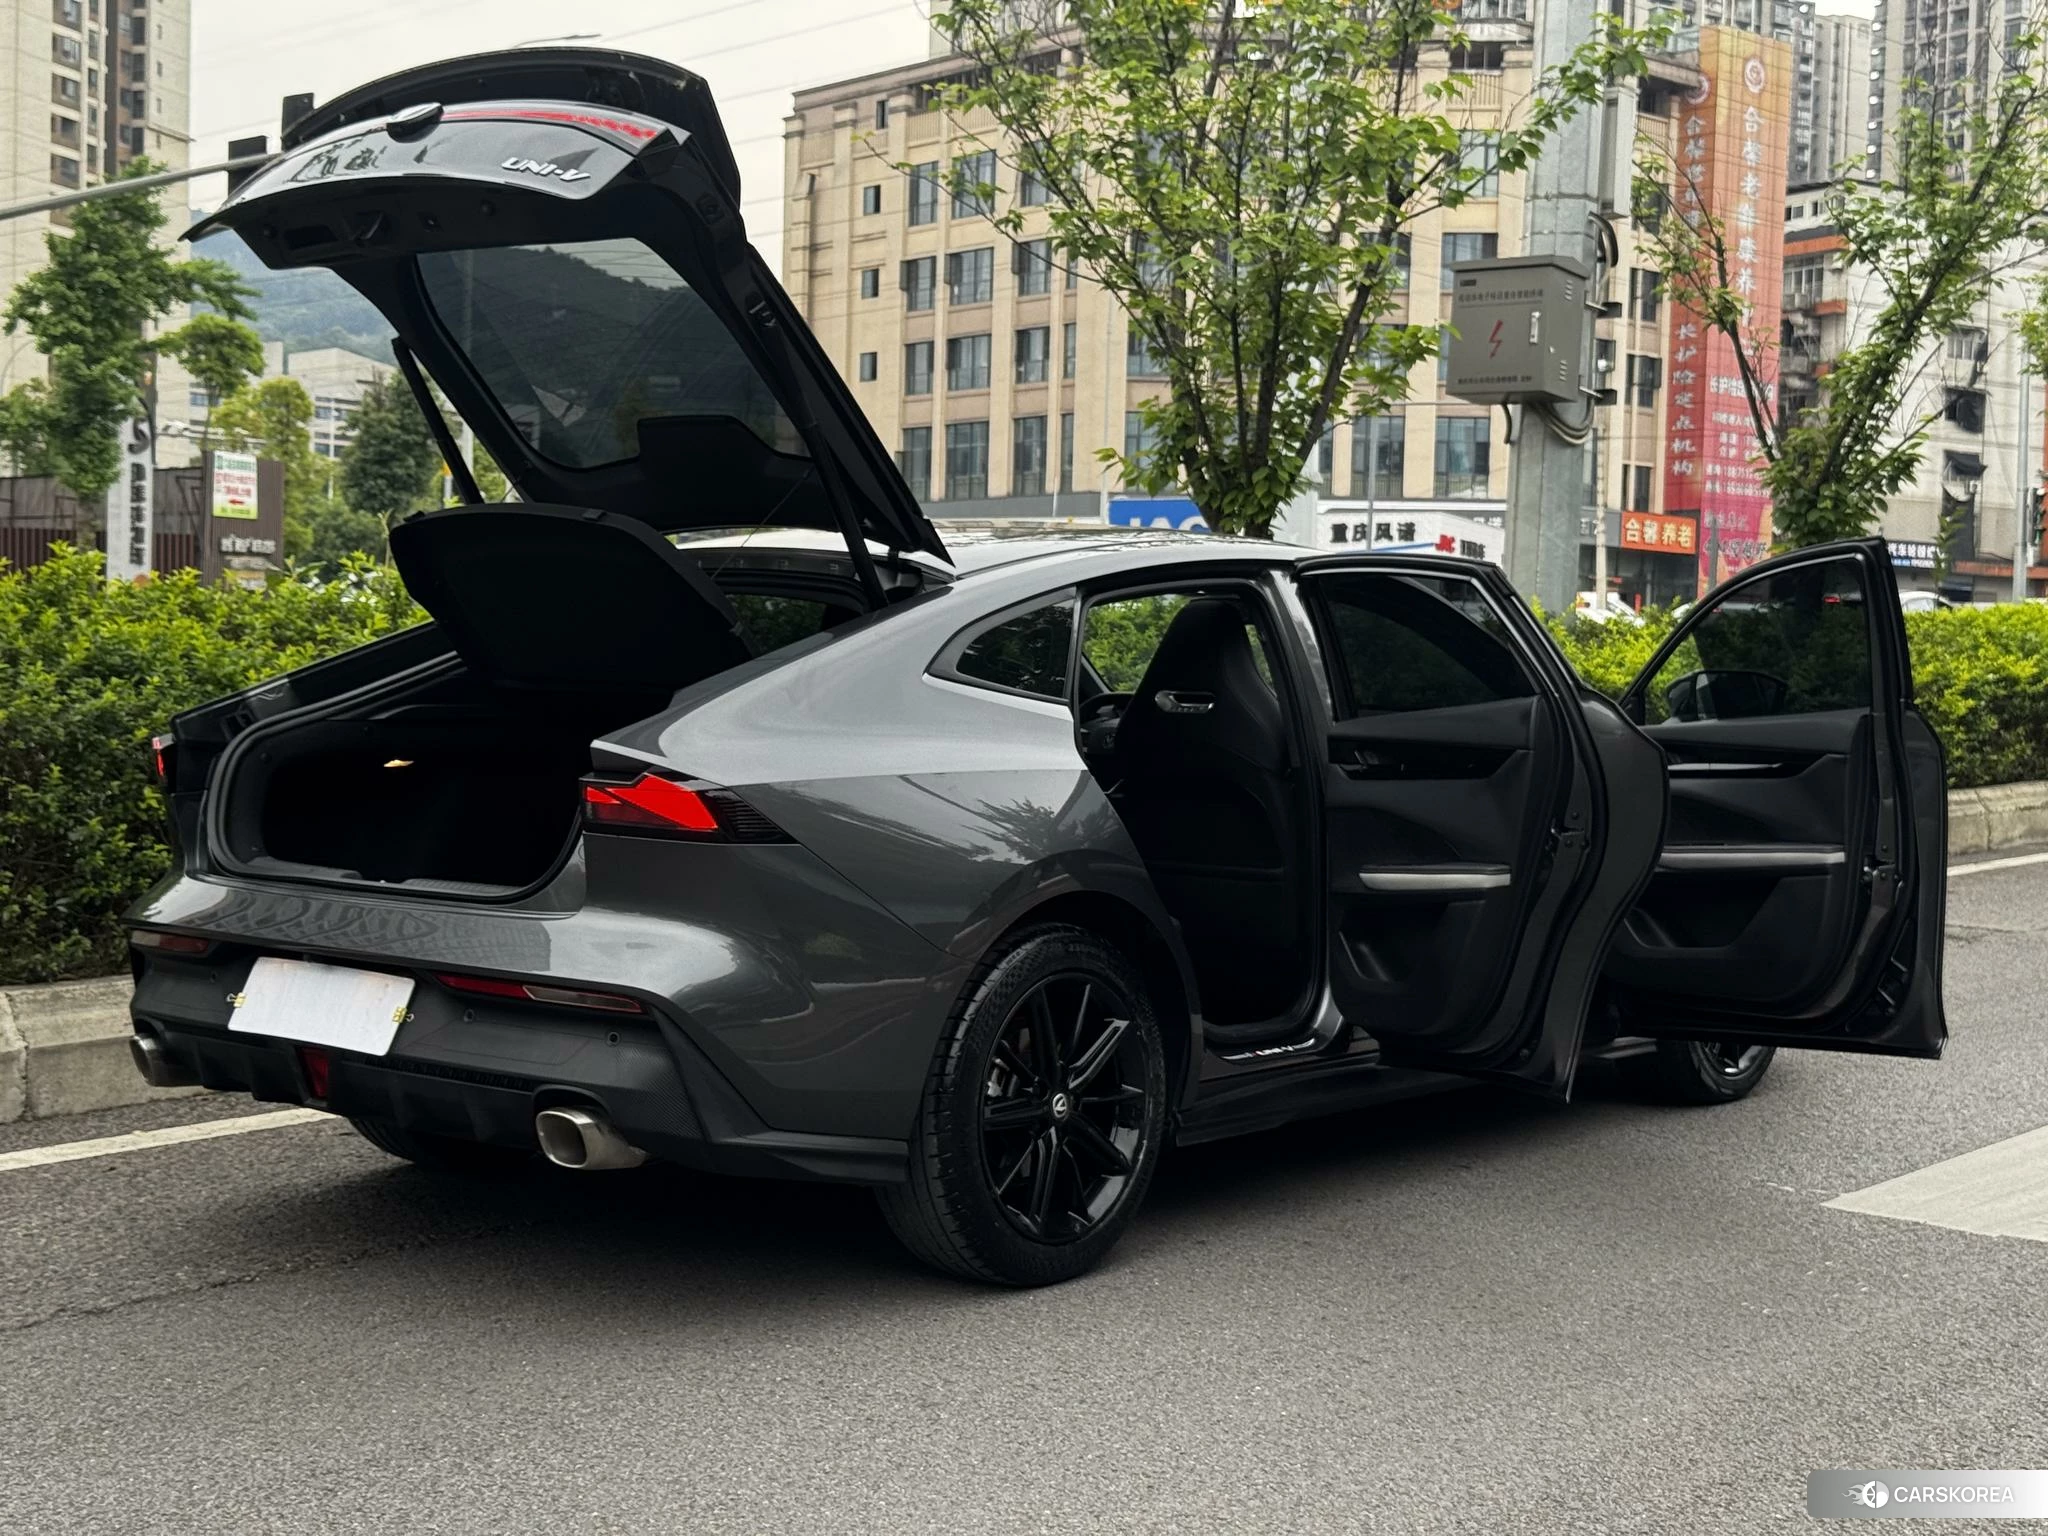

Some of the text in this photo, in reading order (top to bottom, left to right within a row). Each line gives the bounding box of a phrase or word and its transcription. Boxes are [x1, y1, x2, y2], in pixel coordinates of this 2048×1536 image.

[1671, 322, 1698, 476] 长护险定点机构
[1330, 522, 1416, 544] 重庆风诺
[1625, 517, 1692, 548] 合馨养老
